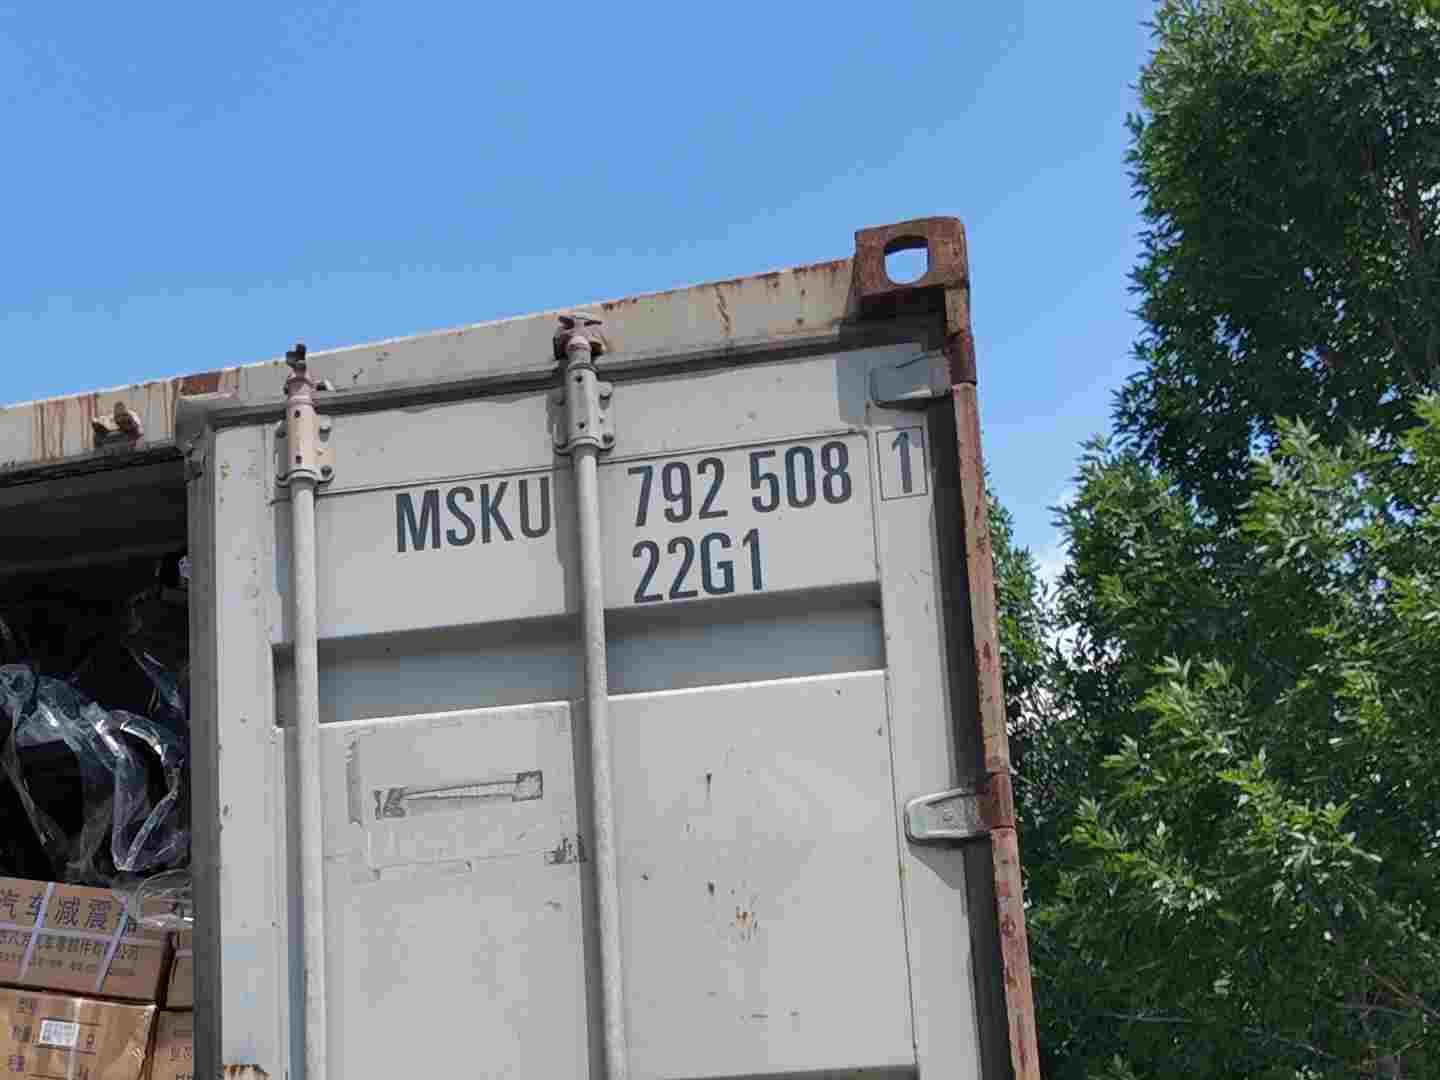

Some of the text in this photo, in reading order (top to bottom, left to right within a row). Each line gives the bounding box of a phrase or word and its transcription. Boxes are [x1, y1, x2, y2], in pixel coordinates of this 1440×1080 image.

[395, 431, 913, 553] MSKU 792 508 1
[632, 527, 767, 603] 22G1
